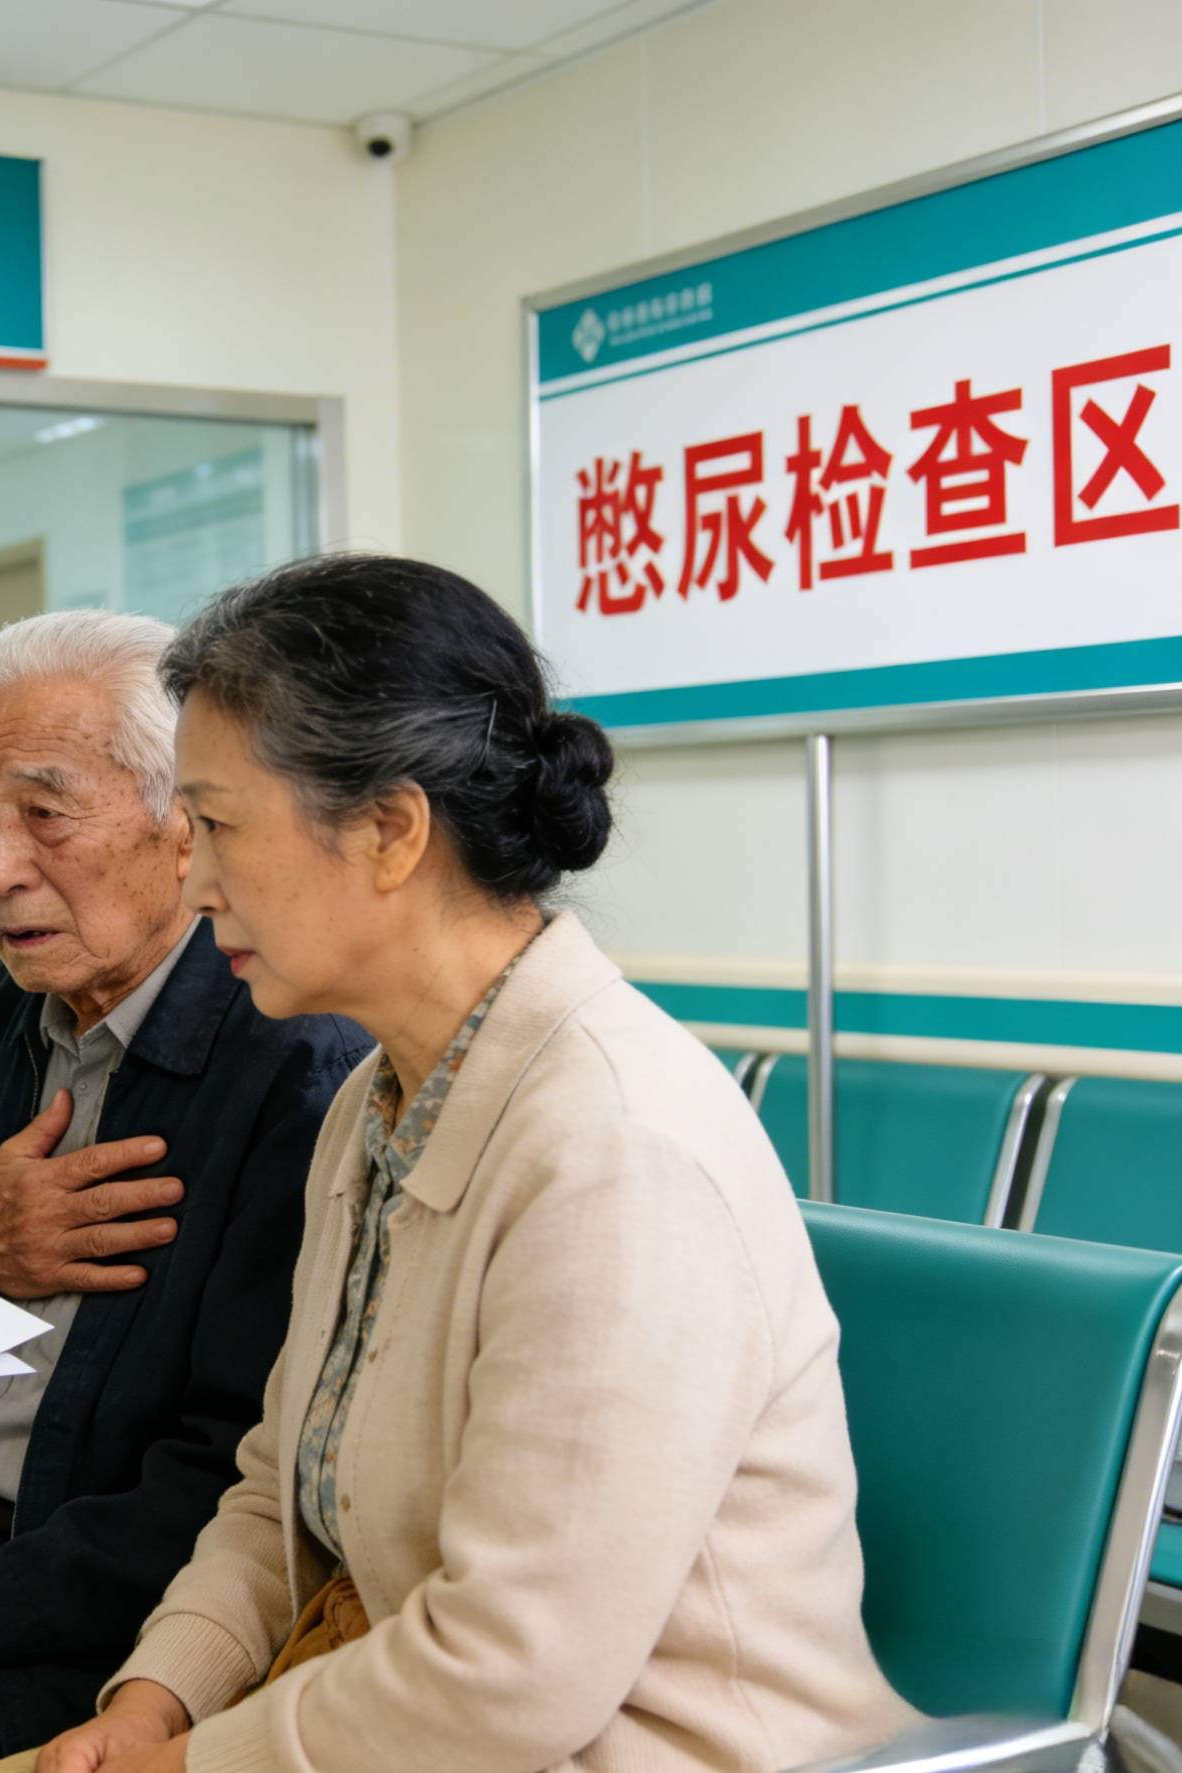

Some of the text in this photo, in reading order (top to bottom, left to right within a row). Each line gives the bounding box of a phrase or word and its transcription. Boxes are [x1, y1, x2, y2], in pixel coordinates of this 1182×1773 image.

[576, 343, 1180, 616] 憋尿检查区
